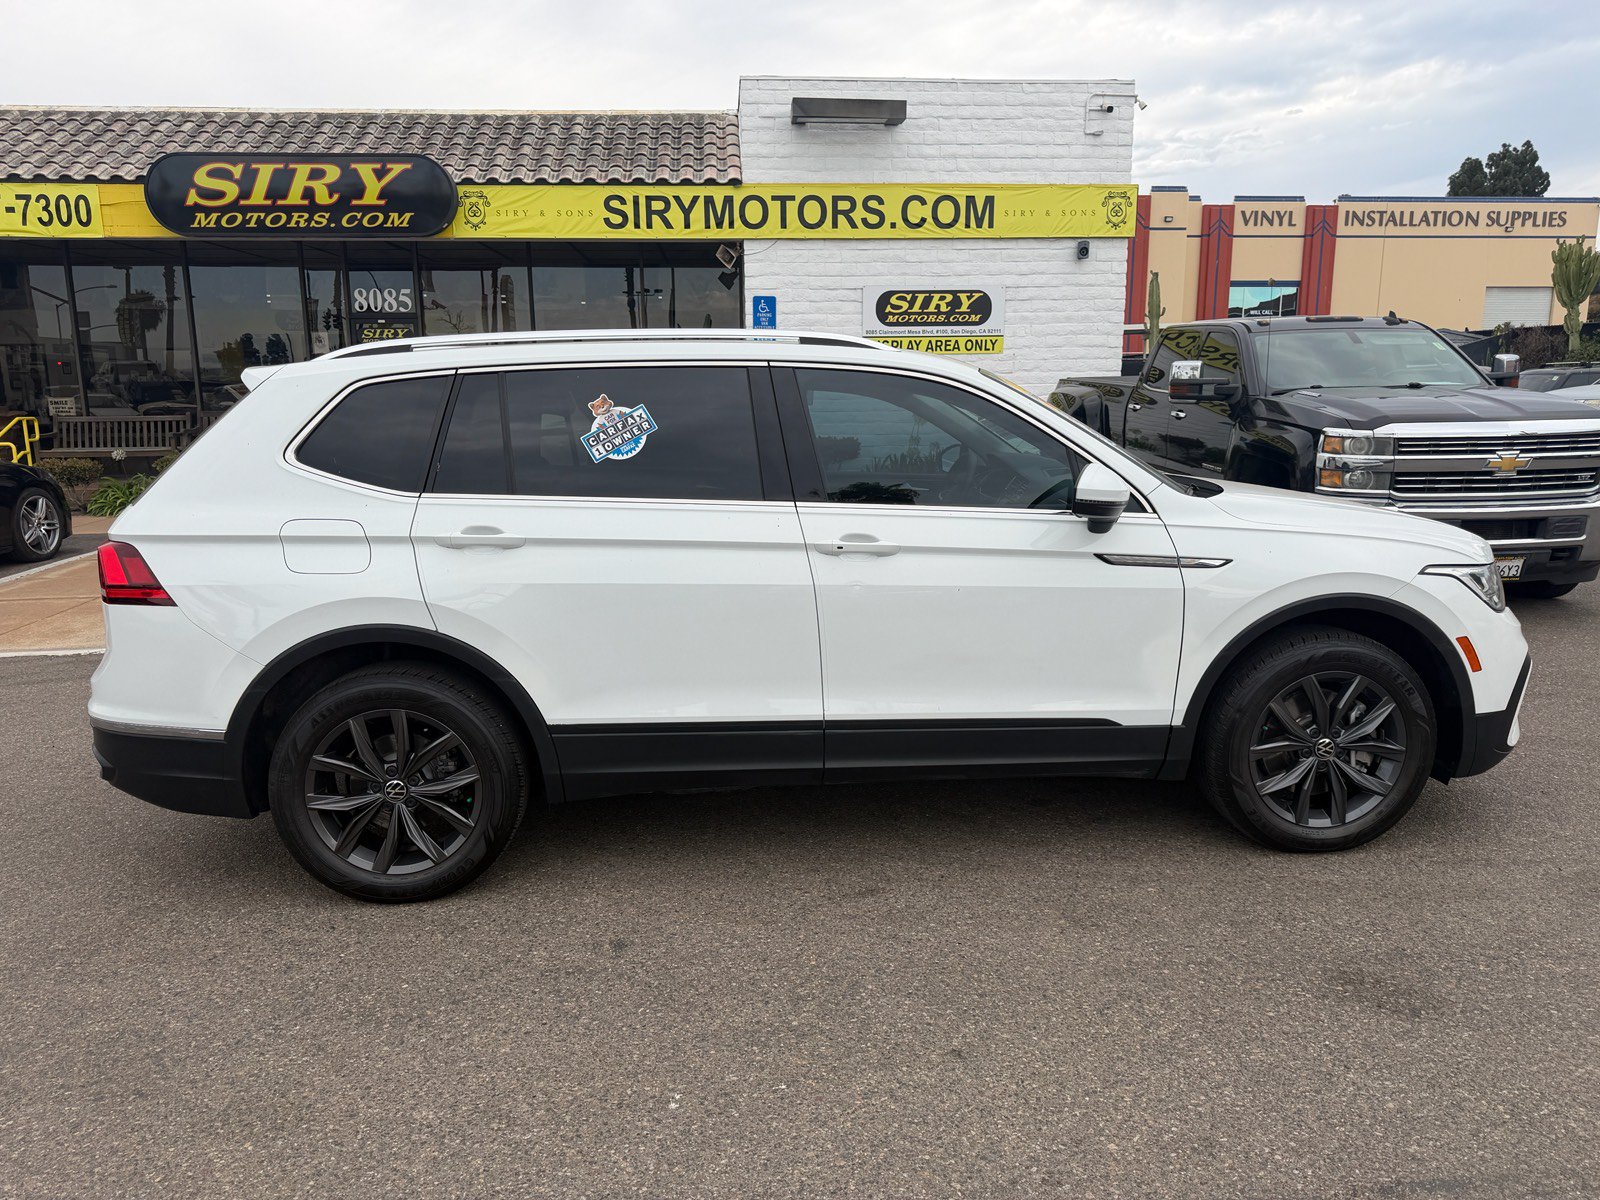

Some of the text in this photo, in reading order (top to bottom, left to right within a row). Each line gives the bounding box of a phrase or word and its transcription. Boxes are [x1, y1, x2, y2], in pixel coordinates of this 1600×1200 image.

[184, 161, 414, 207] SIRY
[0, 193, 92, 228] -7300
[496, 208, 595, 217] SIRY & SONS
[603, 194, 995, 230] SIRYMOTORS.COM
[1004, 208, 1097, 217] SIRY & SONS
[1241, 210, 1297, 227] VINYL
[1344, 210, 1568, 228] INSTALLATION SUPPLIES
[190, 212, 415, 229] MOTORS.COM
[354, 288, 412, 312] 8085
[885, 293, 983, 312] SIRY
[885, 314, 982, 323] MOTORS.COM
[362, 328, 408, 339] SIRY
[878, 339, 998, 352] SPLAY AREA ONLY
[588, 412, 645, 446] CARFAX
[595, 447, 603, 456] 1
[604, 421, 650, 451] OWNER
[1496, 564, 1520, 577] 6Y3
